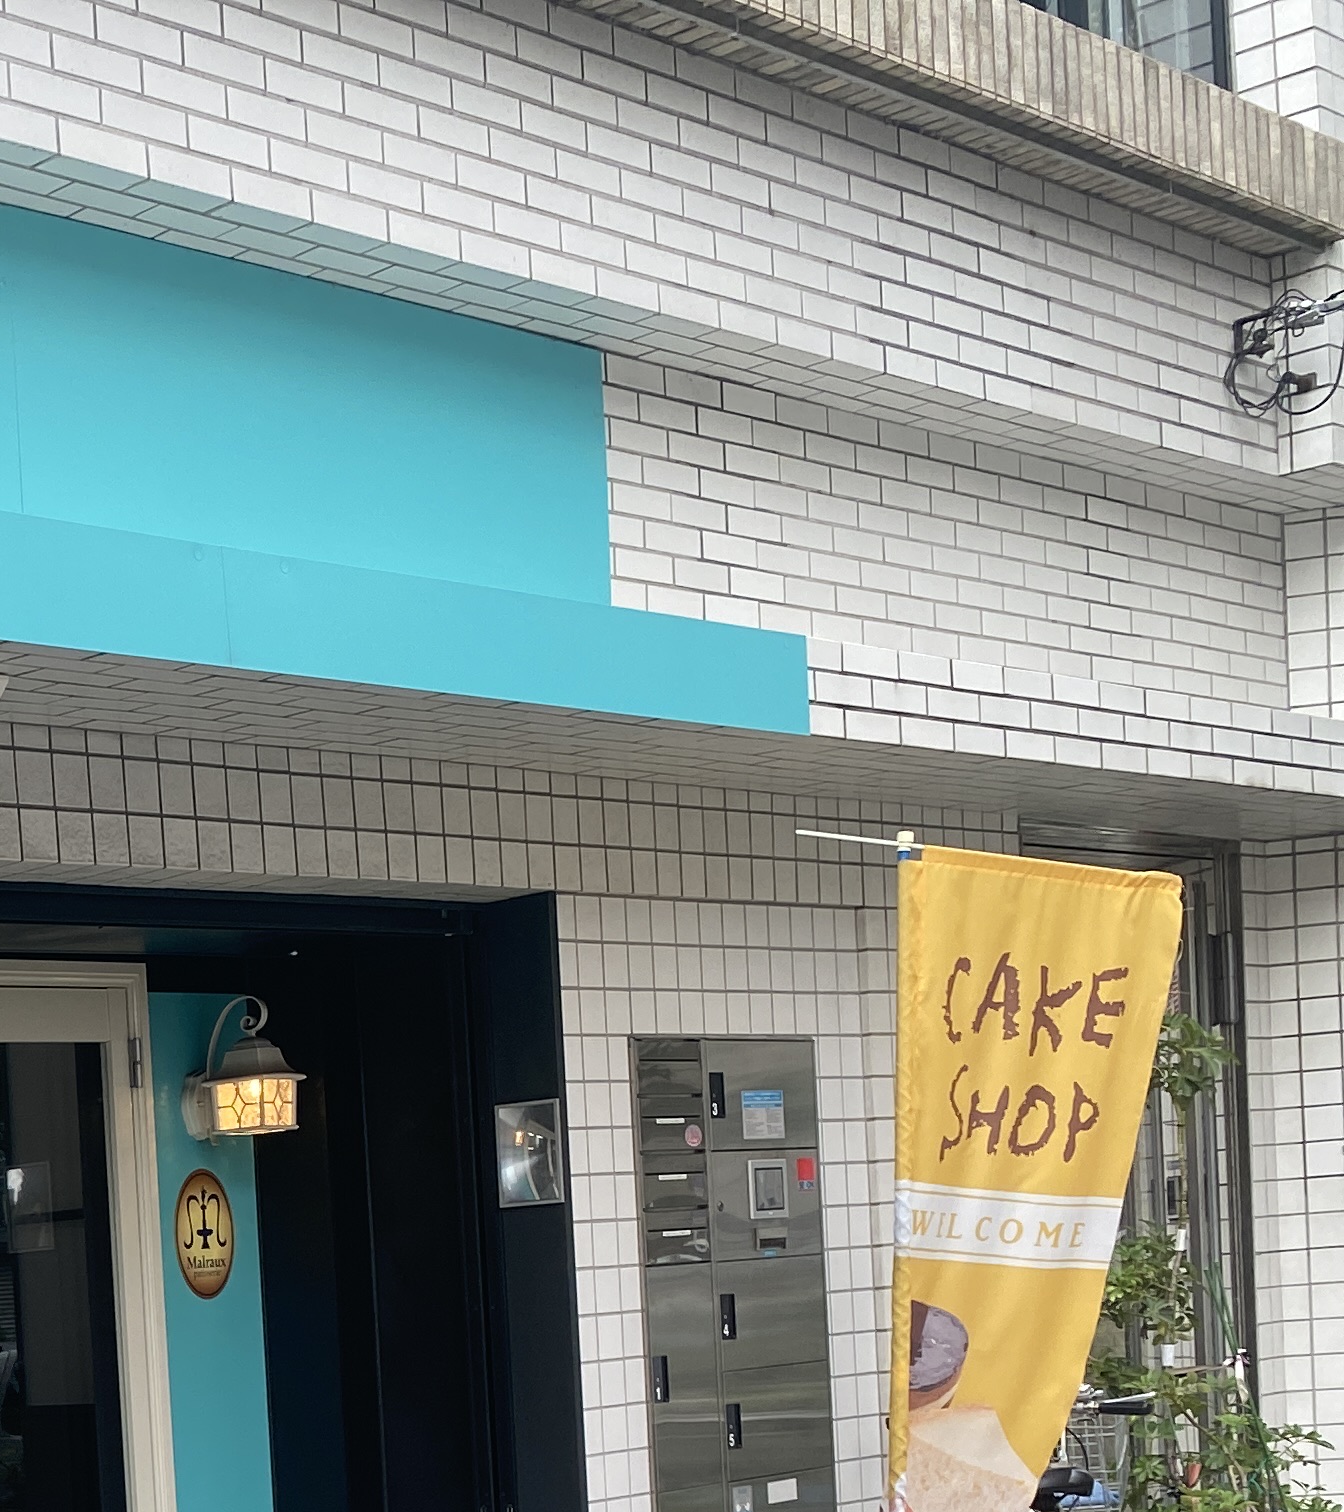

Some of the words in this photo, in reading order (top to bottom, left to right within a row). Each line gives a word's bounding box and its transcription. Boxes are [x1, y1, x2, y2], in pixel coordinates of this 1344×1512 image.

[942, 951, 1129, 1057] CAKE
[711, 1102, 719, 1116] 3
[939, 1064, 1101, 1163] SHOP
[186, 1255, 227, 1271] Malraux
[722, 1323, 730, 1337] 4
[728, 1433, 735, 1447] 5
